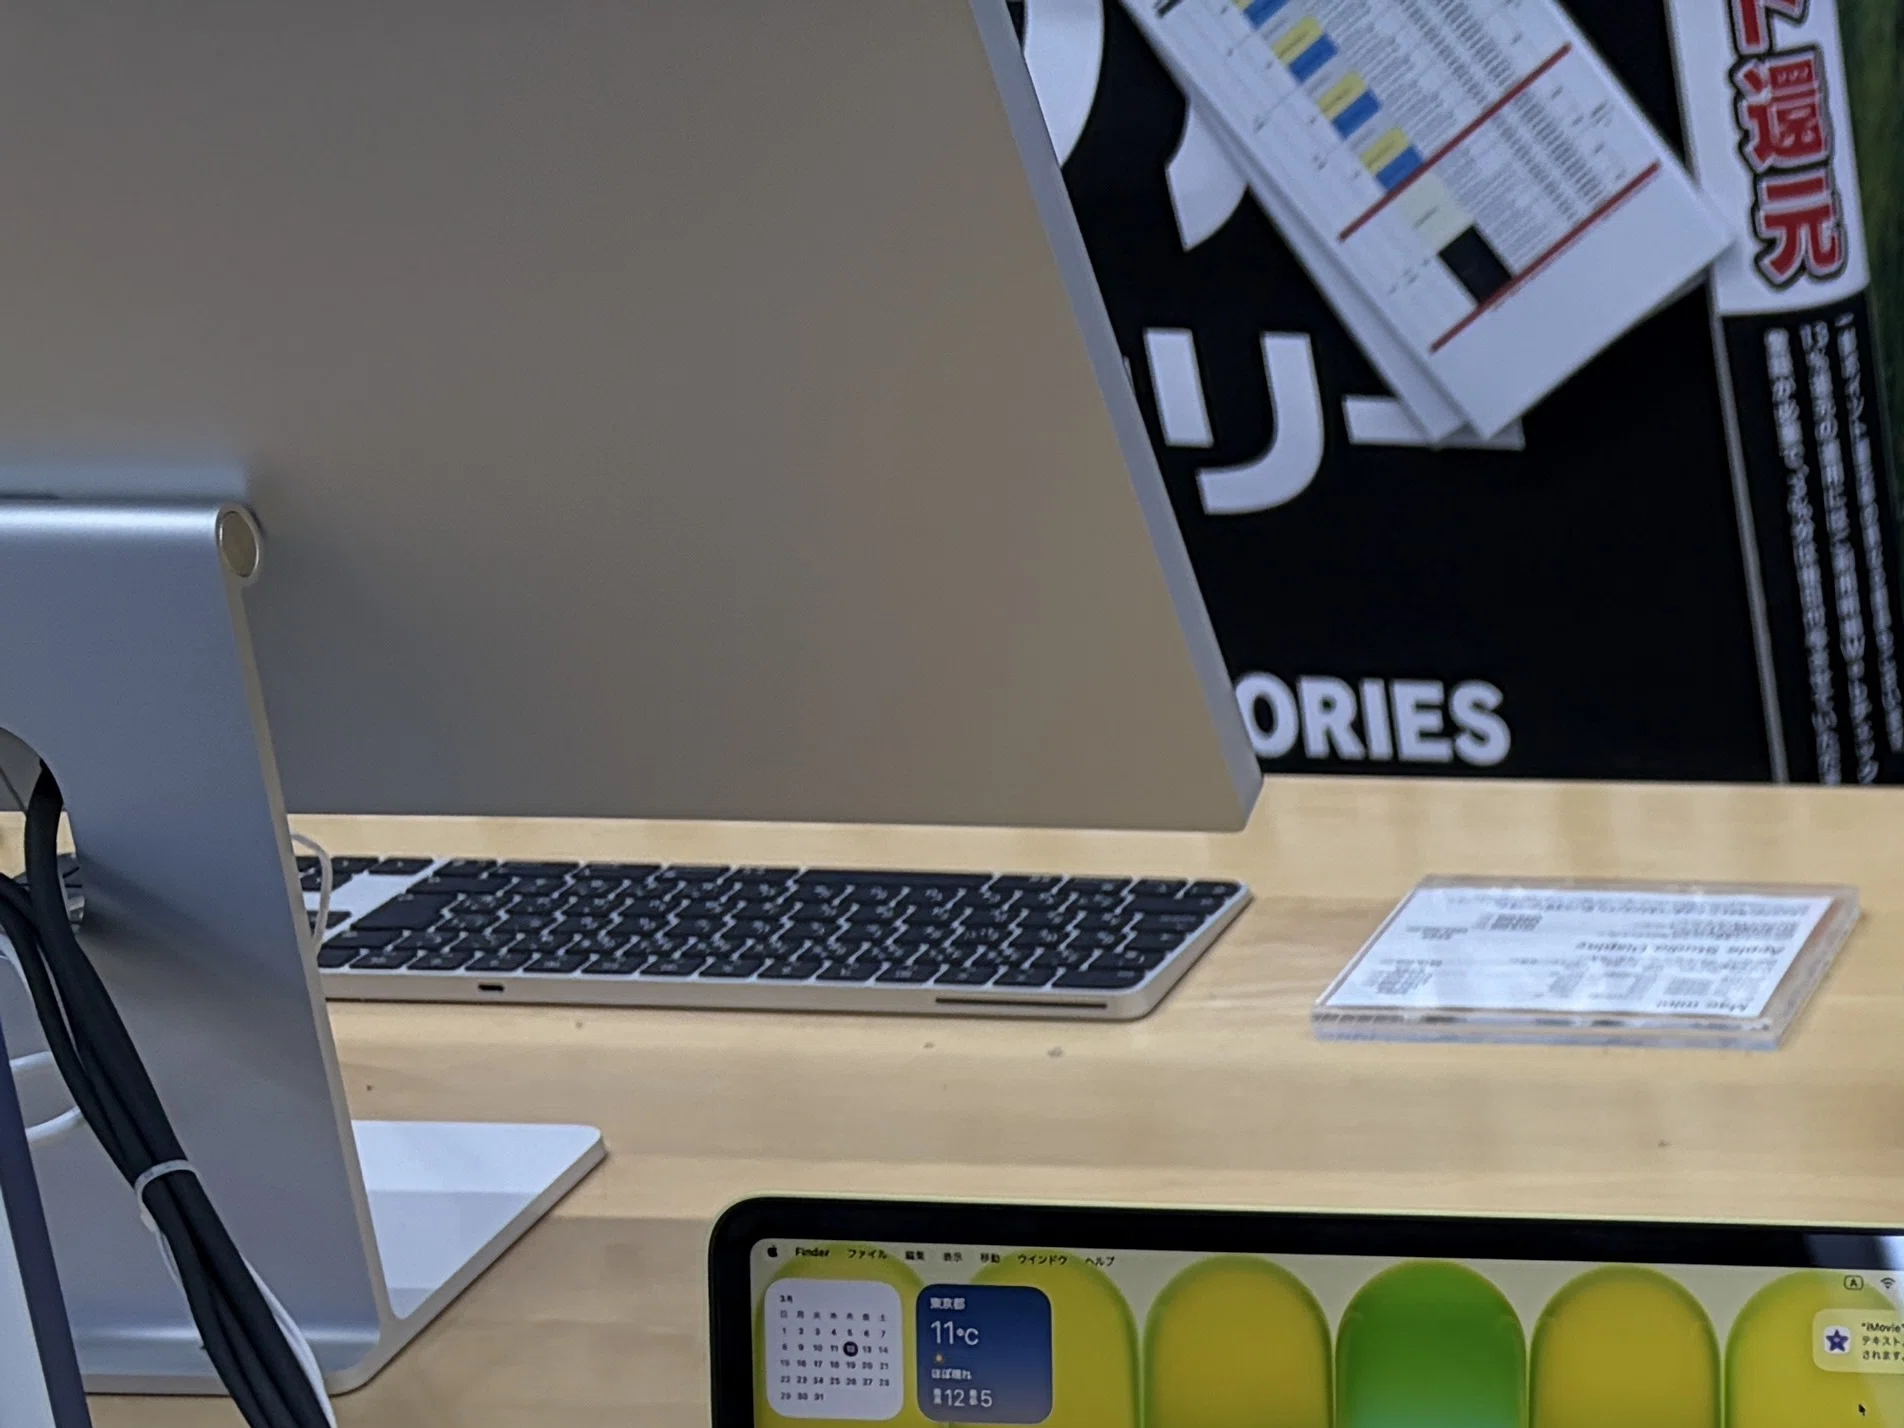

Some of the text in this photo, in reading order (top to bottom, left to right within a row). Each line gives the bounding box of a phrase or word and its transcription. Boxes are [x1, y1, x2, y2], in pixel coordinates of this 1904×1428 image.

[795, 1246, 831, 1258] Finder
[847, 1248, 888, 1260] ファイル
[1018, 1254, 1069, 1267] ウインドウ
[1085, 1255, 1116, 1267] ヘルプ
[929, 1297, 967, 1310] 東京都
